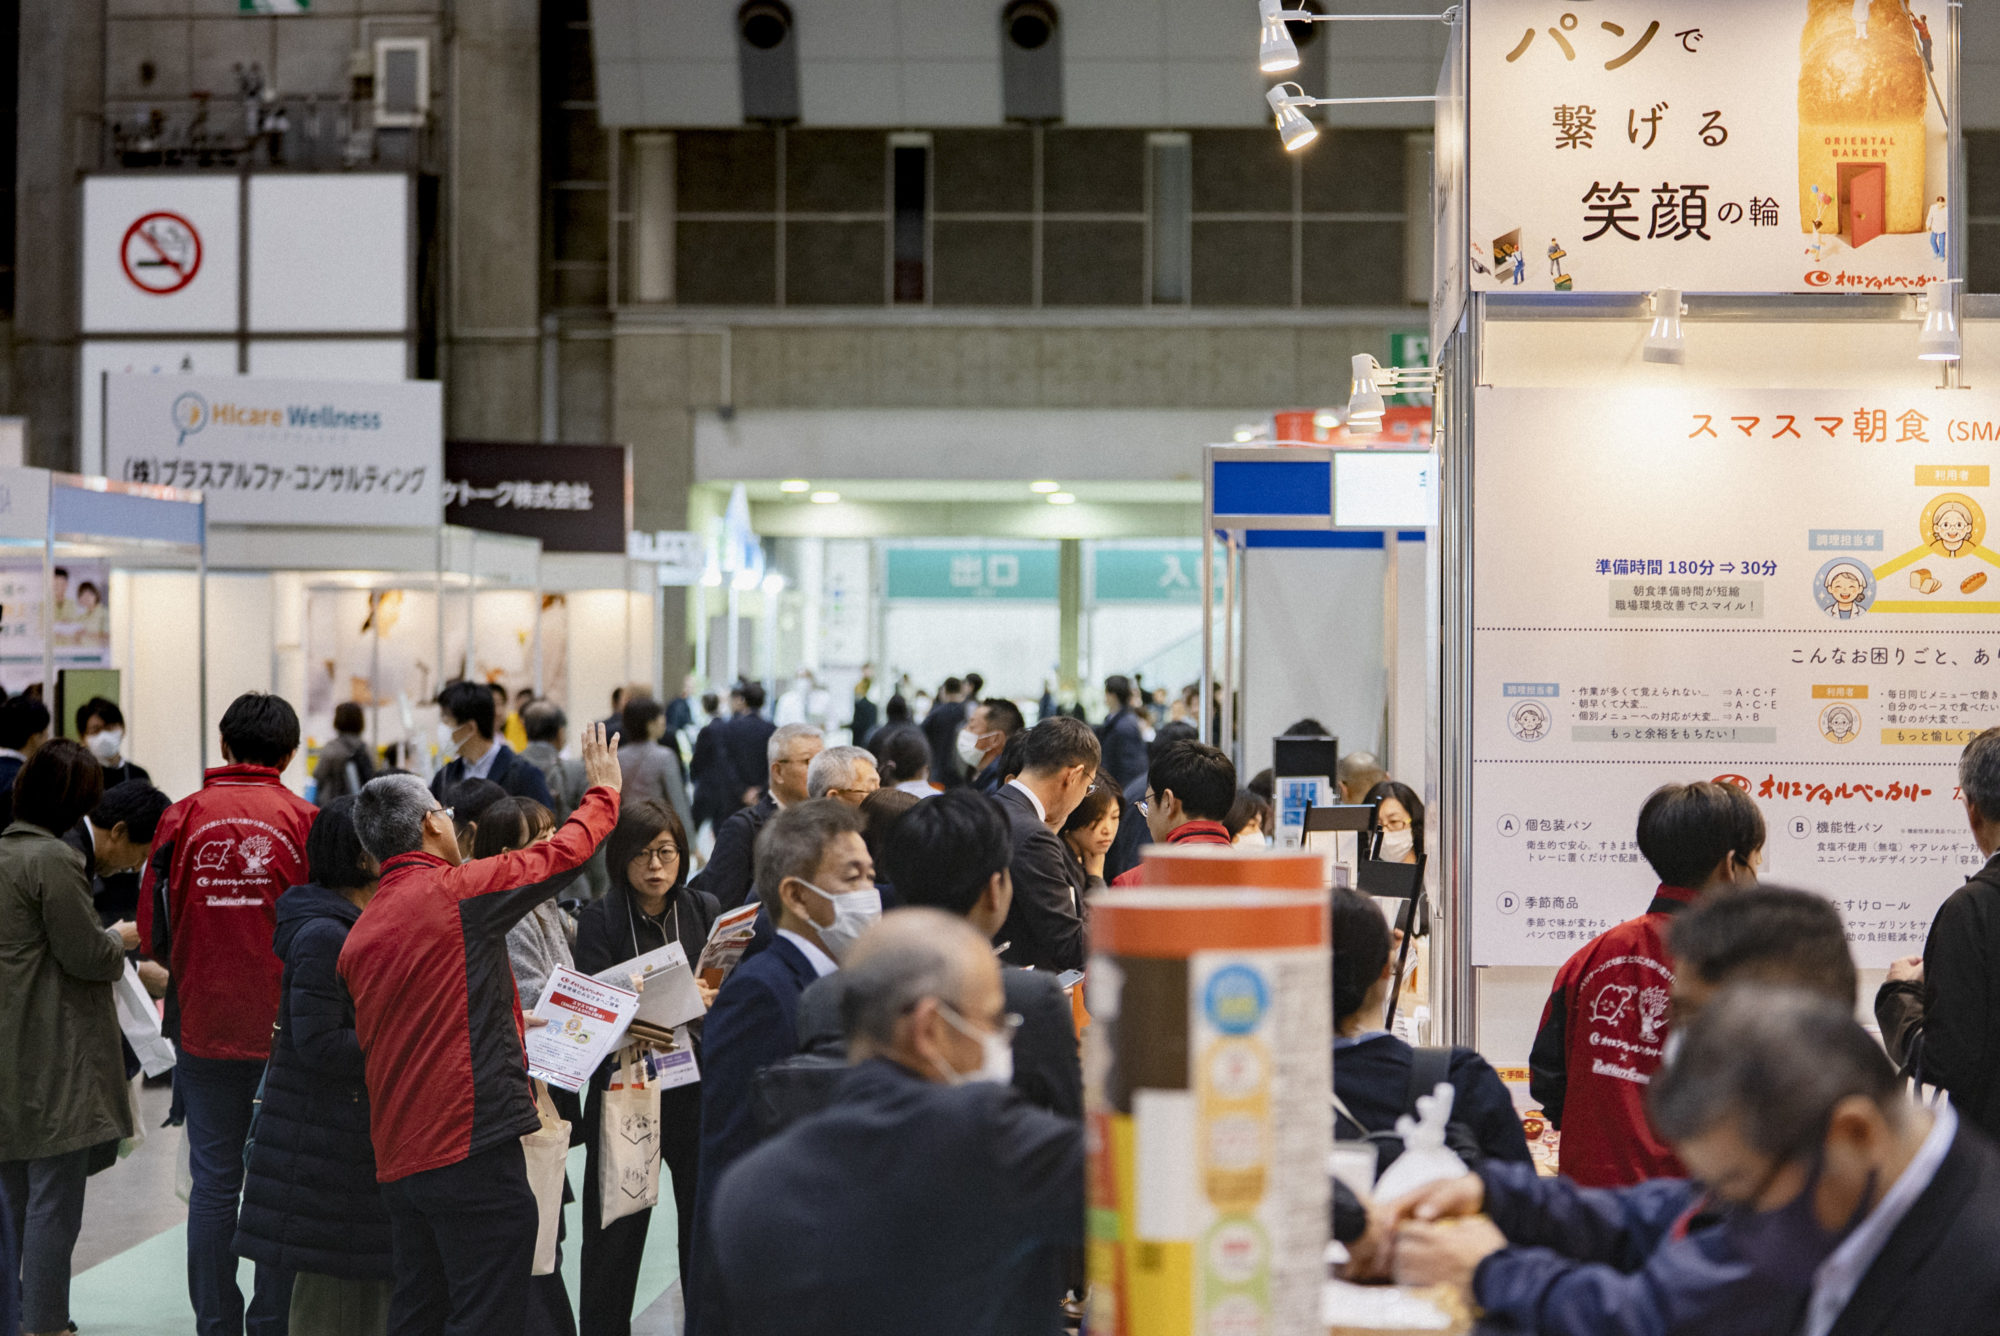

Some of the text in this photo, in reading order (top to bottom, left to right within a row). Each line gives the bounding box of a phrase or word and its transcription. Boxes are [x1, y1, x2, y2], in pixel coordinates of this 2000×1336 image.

[1505, 12, 1704, 71] パンで
[1552, 101, 1729, 151] 繋げる
[1824, 136, 1895, 146] ORIENTAL
[1832, 148, 1888, 158] BAKERY
[1582, 181, 1780, 242] 笑顔の輪
[286, 405, 382, 430] Wellness
[1688, 406, 1930, 444] スマスマ朝食
[1935, 470, 1969, 482] 利用者
[1595, 558, 1777, 576] 準備時間 180分 30分
[1633, 585, 1740, 597] 朝食準備時間が短縮
[1615, 600, 1755, 612] 職場環境改善でスマイル!
[1791, 647, 2000, 666] こんなお困りごと、あ
[1826, 687, 1854, 697] 利用者
[1610, 728, 1737, 740] もっと余裕をもちたい!
[1758, 774, 1932, 806] オリエンタルベーカリー
[1504, 820, 1513, 831] A
[1525, 818, 1592, 832] 個包装パン
[1795, 822, 1804, 833] B
[1816, 821, 1883, 834] 機能性パン
[1504, 897, 1513, 908] D
[1525, 896, 1579, 910] 季節商品
[1526, 931, 1603, 941] パンで四季を感
